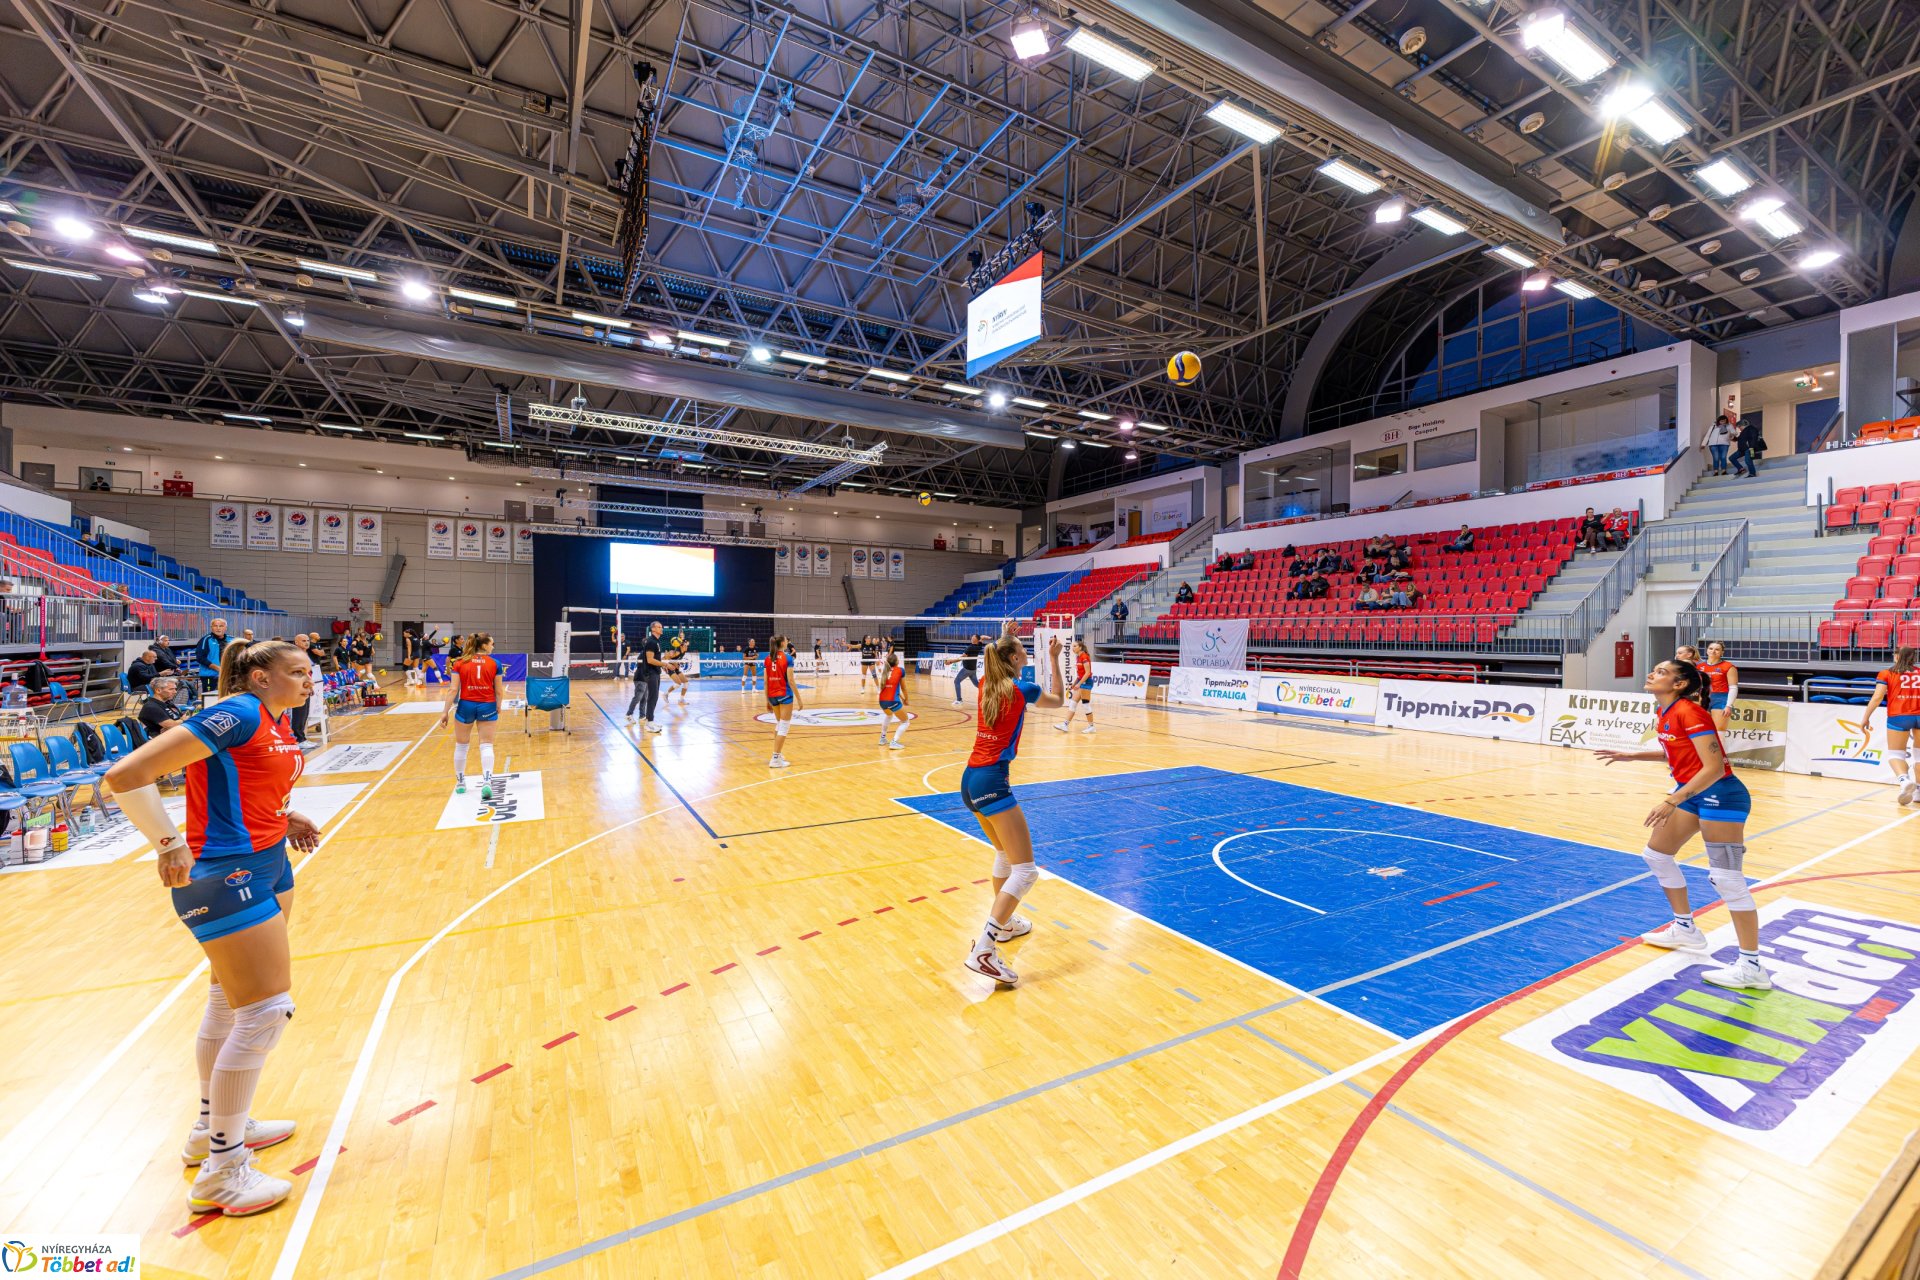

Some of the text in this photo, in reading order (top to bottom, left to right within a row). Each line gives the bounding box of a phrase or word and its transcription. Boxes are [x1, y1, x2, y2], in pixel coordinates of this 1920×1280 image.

[1092, 673, 1146, 688] ppmixPRO
[1204, 677, 1249, 689] TippmixPRO
[1900, 674, 1920, 689] 22
[1202, 688, 1247, 700] EXTRALIGA
[1299, 685, 1341, 695] NYÍREGYHÁZA
[1298, 692, 1355, 709] Többet ad!
[1383, 692, 1536, 724] TippmixPRO
[1568, 694, 1767, 723] Környezet san
[1597, 717, 1658, 735] nyíregyh
[1724, 727, 1774, 742] ortért
[290, 754, 303, 781] 11
[238, 886, 252, 902] 11
